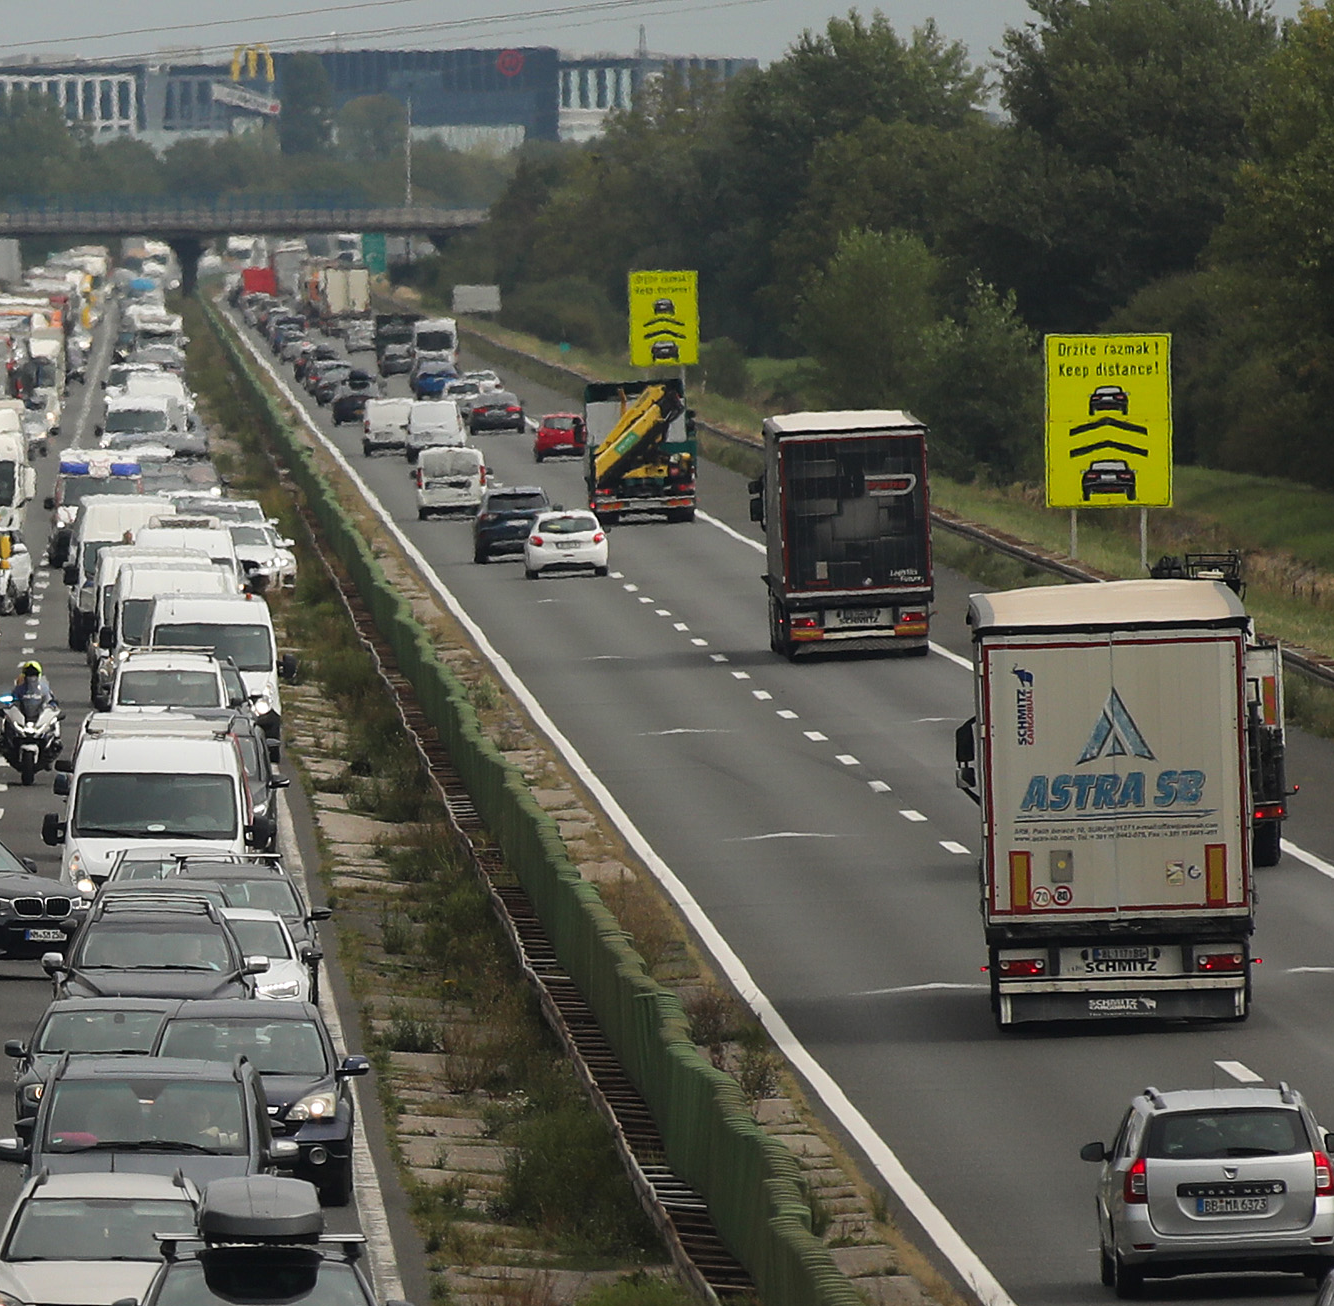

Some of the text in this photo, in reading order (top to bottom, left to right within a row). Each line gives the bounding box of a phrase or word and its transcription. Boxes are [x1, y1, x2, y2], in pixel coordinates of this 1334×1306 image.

[1059, 361, 1159, 378] Keep distance!
[1017, 689, 1027, 746] SCHMITZ
[1020, 769, 1206, 811] ASTRA SB
[1035, 891, 1049, 903] 70
[1056, 890, 1068, 901] 80
[1085, 961, 1157, 973] SCHMITZ
[1088, 998, 1138, 1006] SCHMITZ
